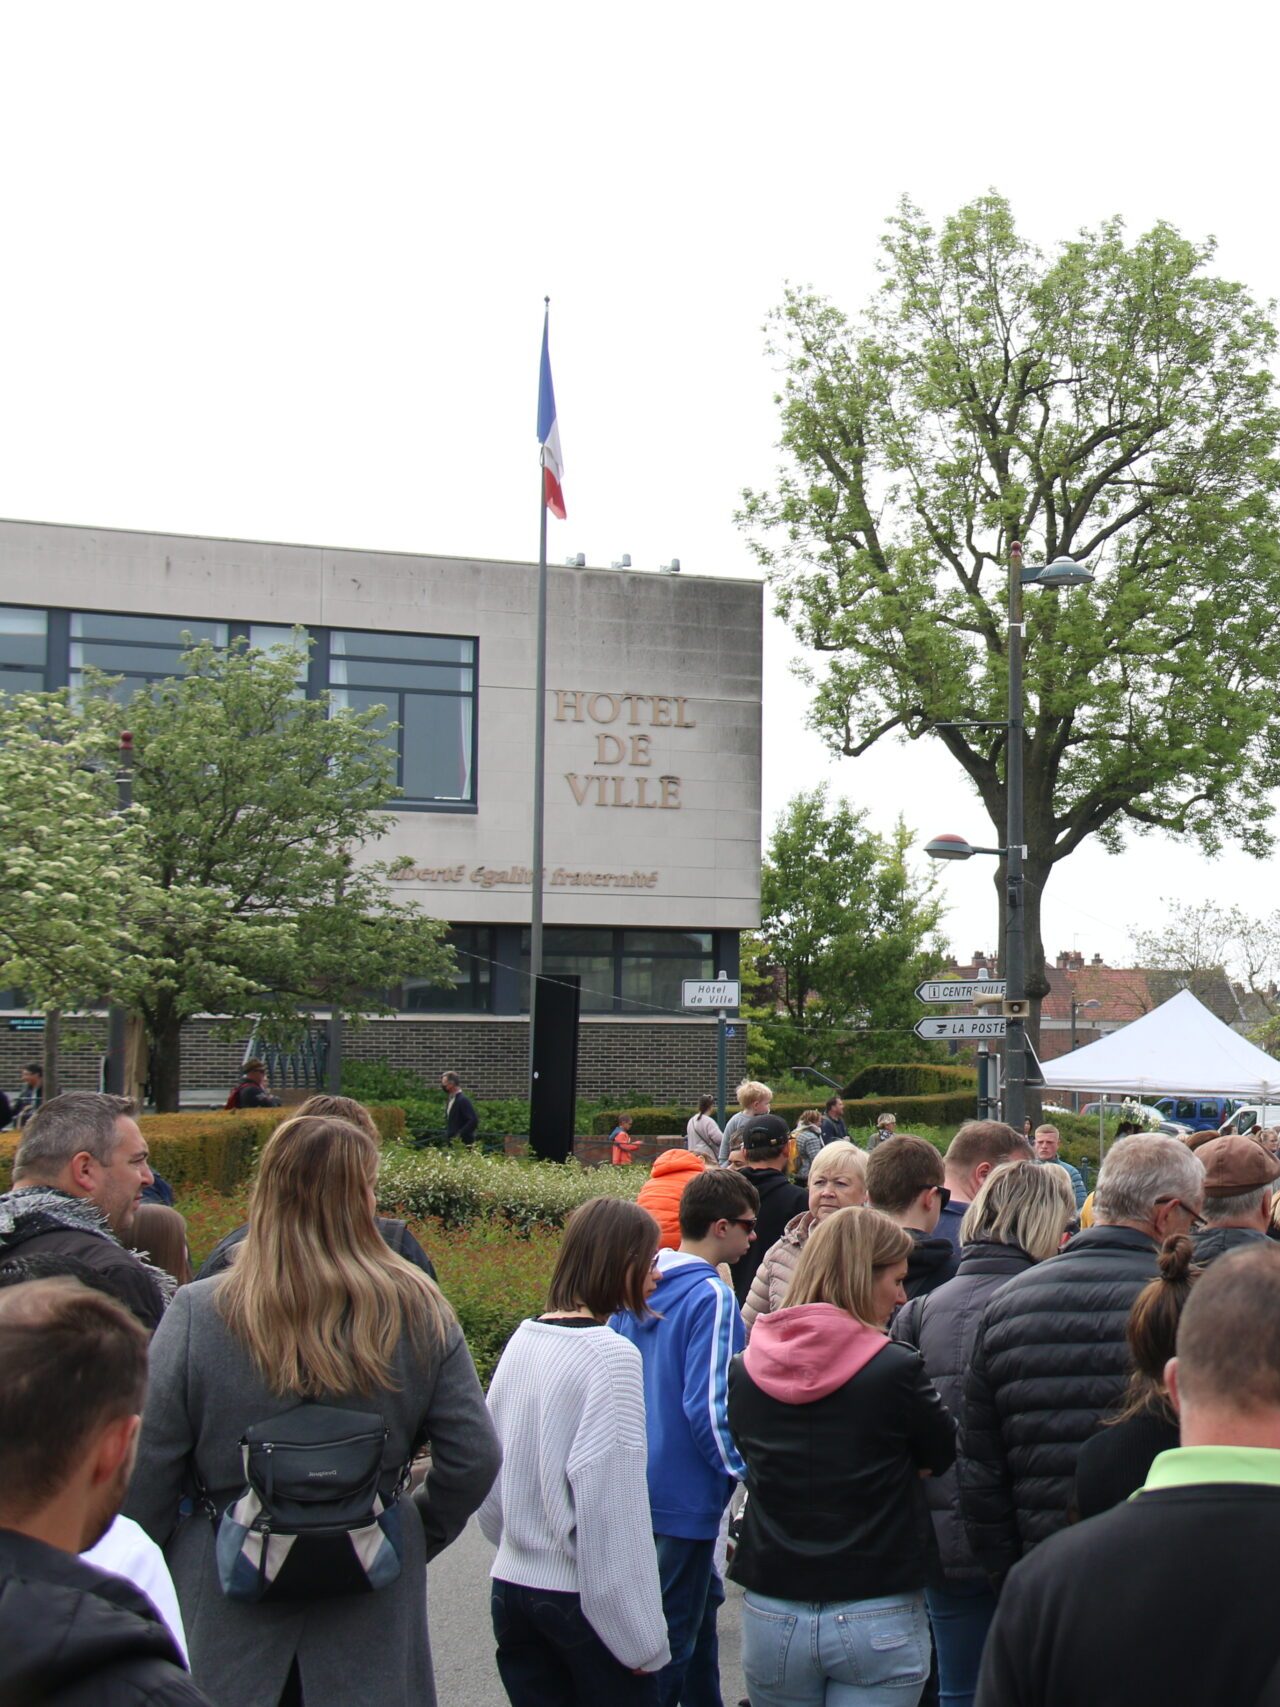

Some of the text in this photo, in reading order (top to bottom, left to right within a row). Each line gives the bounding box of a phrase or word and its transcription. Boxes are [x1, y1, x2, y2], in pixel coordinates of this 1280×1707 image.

[553, 691, 696, 728] HOTEL
[594, 733, 652, 766] DE
[564, 773, 681, 809] VILLE
[470, 866, 546, 888] égalit
[549, 868, 658, 888] fraternité
[690, 995, 732, 1003] de Ville
[698, 985, 725, 993] Hôtel
[952, 1023, 1006, 1034] LA POSTE
